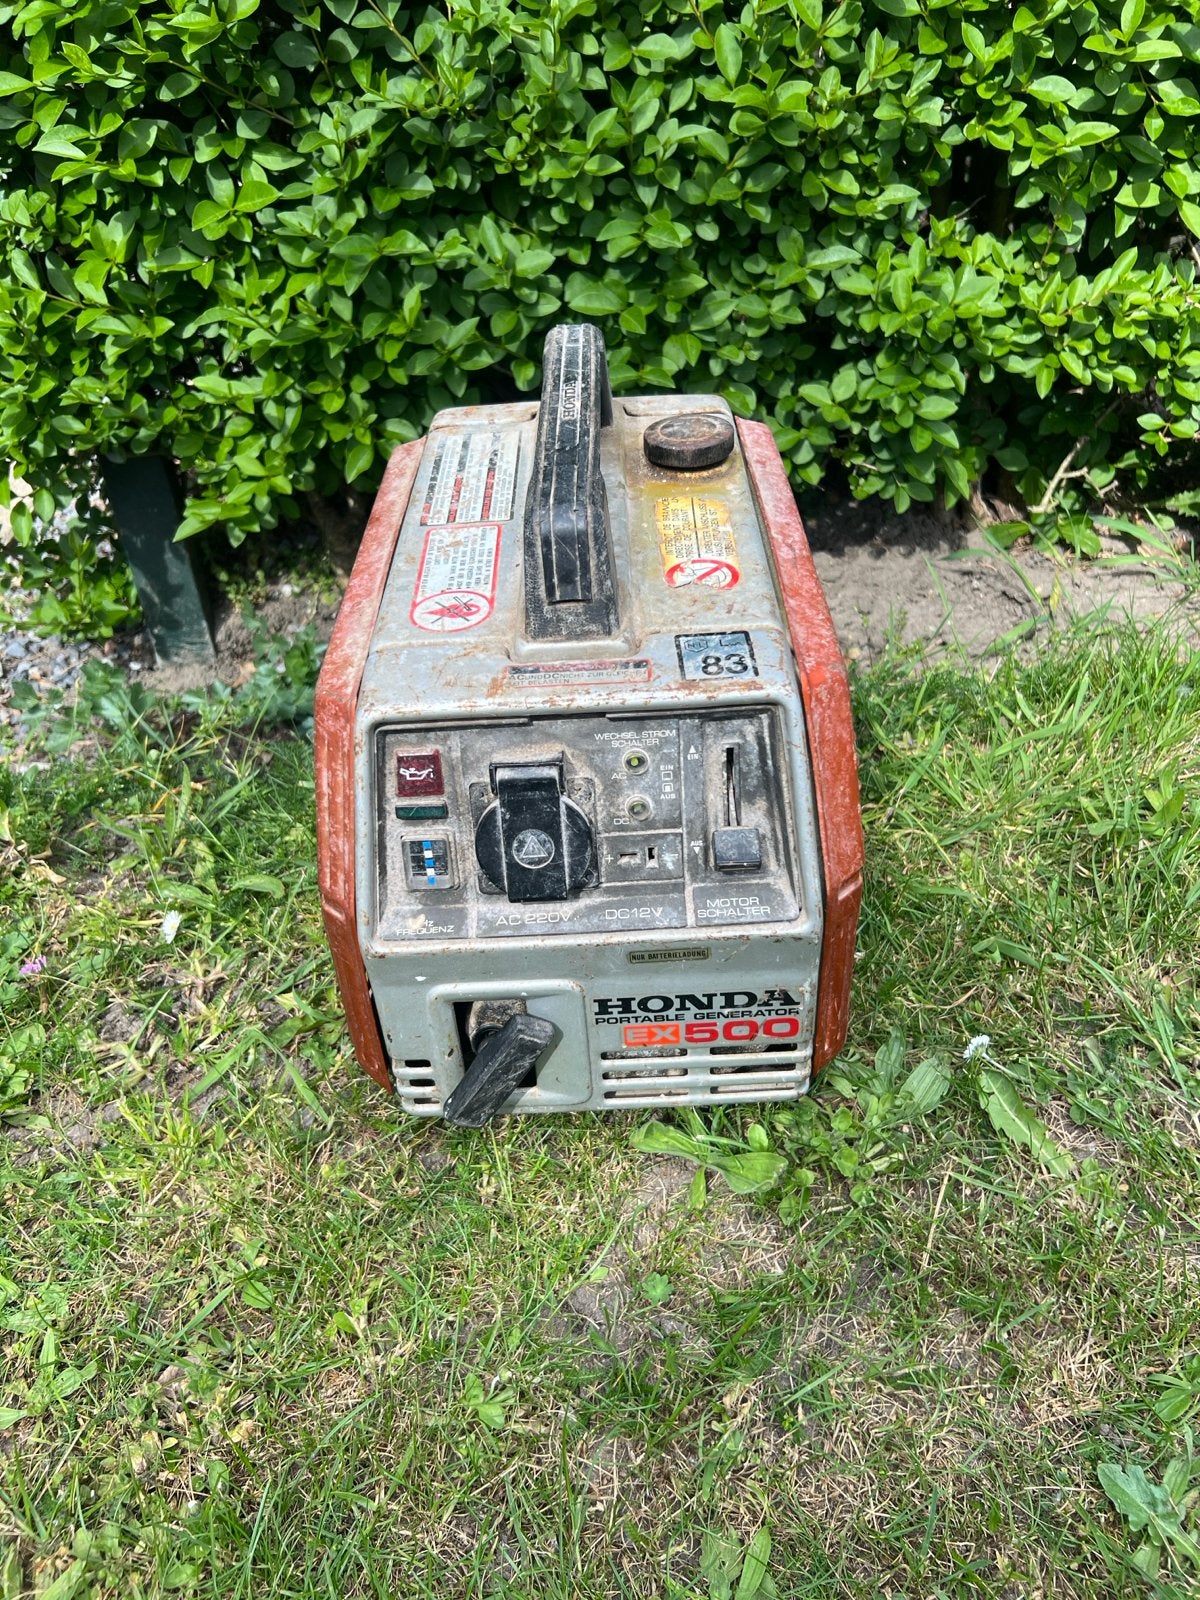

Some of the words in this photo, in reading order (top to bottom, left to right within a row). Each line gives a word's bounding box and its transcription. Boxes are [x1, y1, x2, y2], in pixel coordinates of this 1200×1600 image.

[563, 381, 576, 418] HONDA
[702, 653, 749, 675] 83
[594, 731, 640, 741] WECHSEL
[641, 729, 676, 739] STROM
[611, 738, 660, 748] SCHALTER
[613, 817, 630, 825] DC
[706, 896, 760, 908] MOTOR
[496, 914, 522, 927] AC
[526, 911, 572, 924] 220V
[604, 907, 663, 921] DC12V
[697, 905, 771, 919] SCHALTER
[396, 925, 455, 936] FREQUENZ
[631, 952, 646, 961] NUR
[647, 950, 707, 960] BATTERIELADUNG
[593, 989, 801, 1016] HONDA
[595, 1013, 685, 1025] PORTABLE
[693, 1008, 800, 1021] GENERATOR
